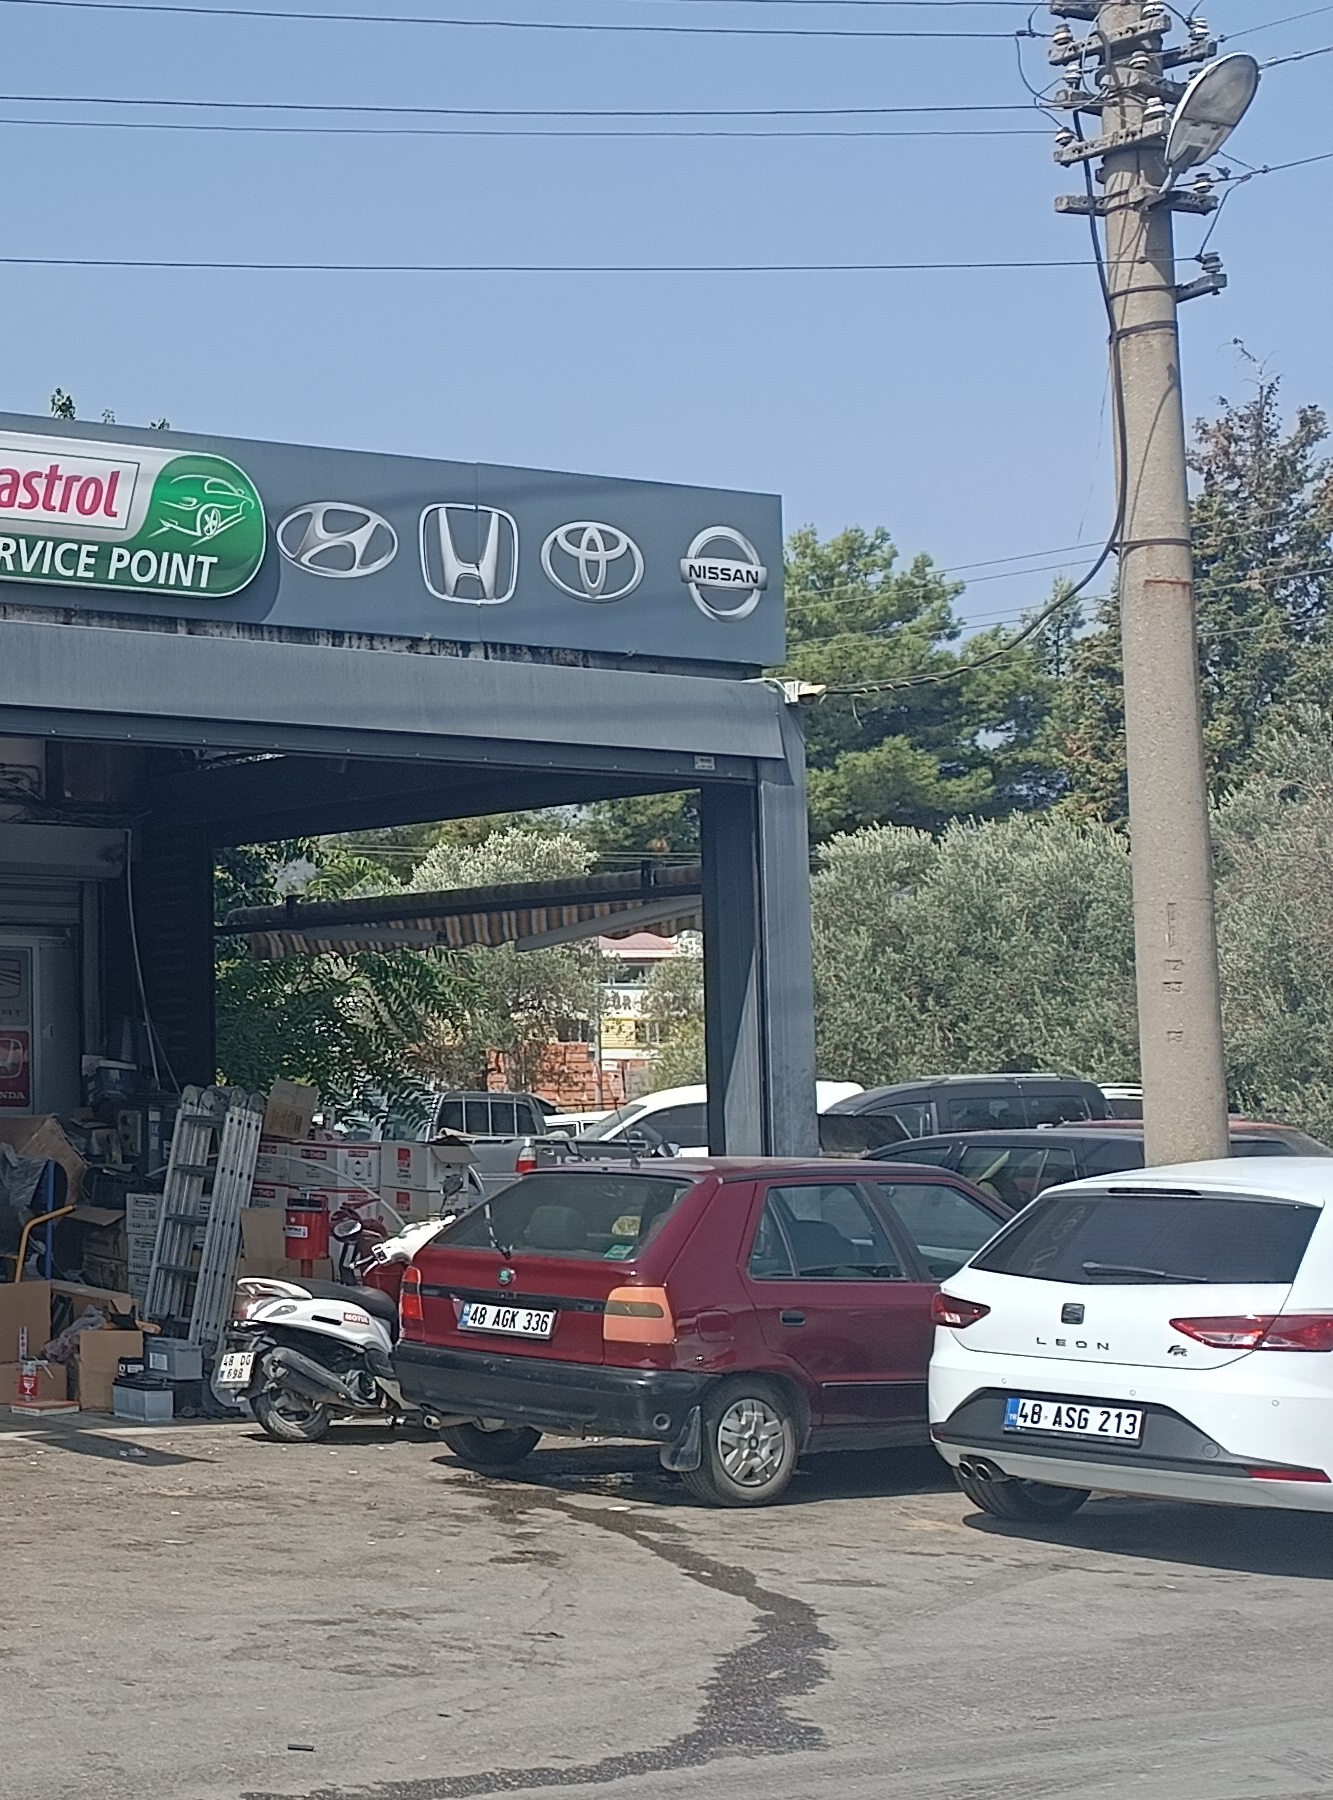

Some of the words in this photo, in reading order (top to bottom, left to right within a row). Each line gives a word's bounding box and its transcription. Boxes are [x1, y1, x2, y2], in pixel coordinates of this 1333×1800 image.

[108, 550, 219, 588] POINT
[688, 563, 759, 584] NISSAN
[345, 1314, 369, 1323] MOTUL
[470, 1306, 487, 1325] 48
[492, 1307, 519, 1331] AGK
[523, 1310, 550, 1334] 336
[1036, 1337, 1110, 1351] LEON
[223, 1355, 235, 1367] 48
[227, 1367, 244, 1380] 698
[1018, 1402, 1043, 1425] 48
[1051, 1405, 1091, 1431] ASG
[1098, 1410, 1138, 1436] 213
